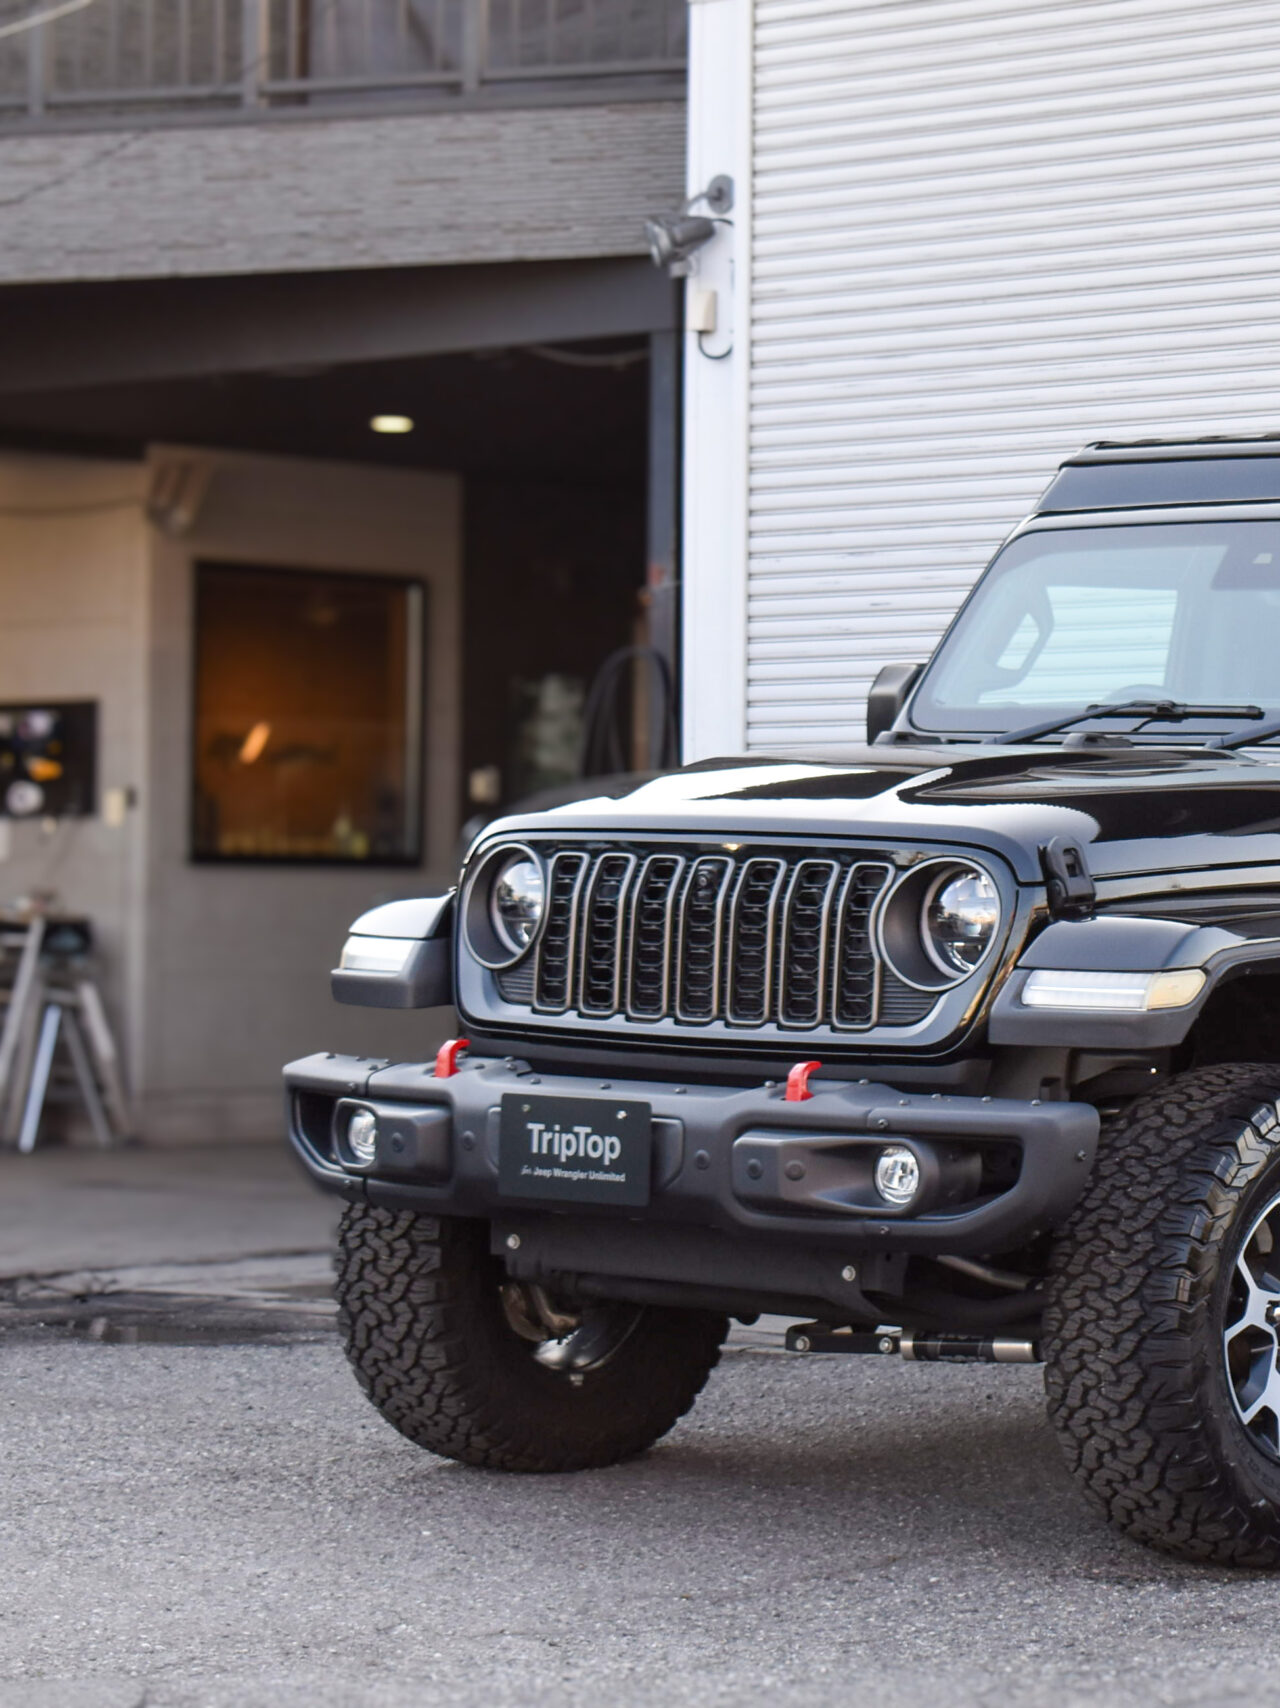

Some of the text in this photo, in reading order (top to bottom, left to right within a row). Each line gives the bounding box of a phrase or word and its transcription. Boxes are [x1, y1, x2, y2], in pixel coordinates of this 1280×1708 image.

[526, 1122, 621, 1165] TripTop
[533, 1166, 553, 1178] Jeep
[553, 1168, 588, 1180] Wrangler
[588, 1170, 626, 1182] Unlimited
